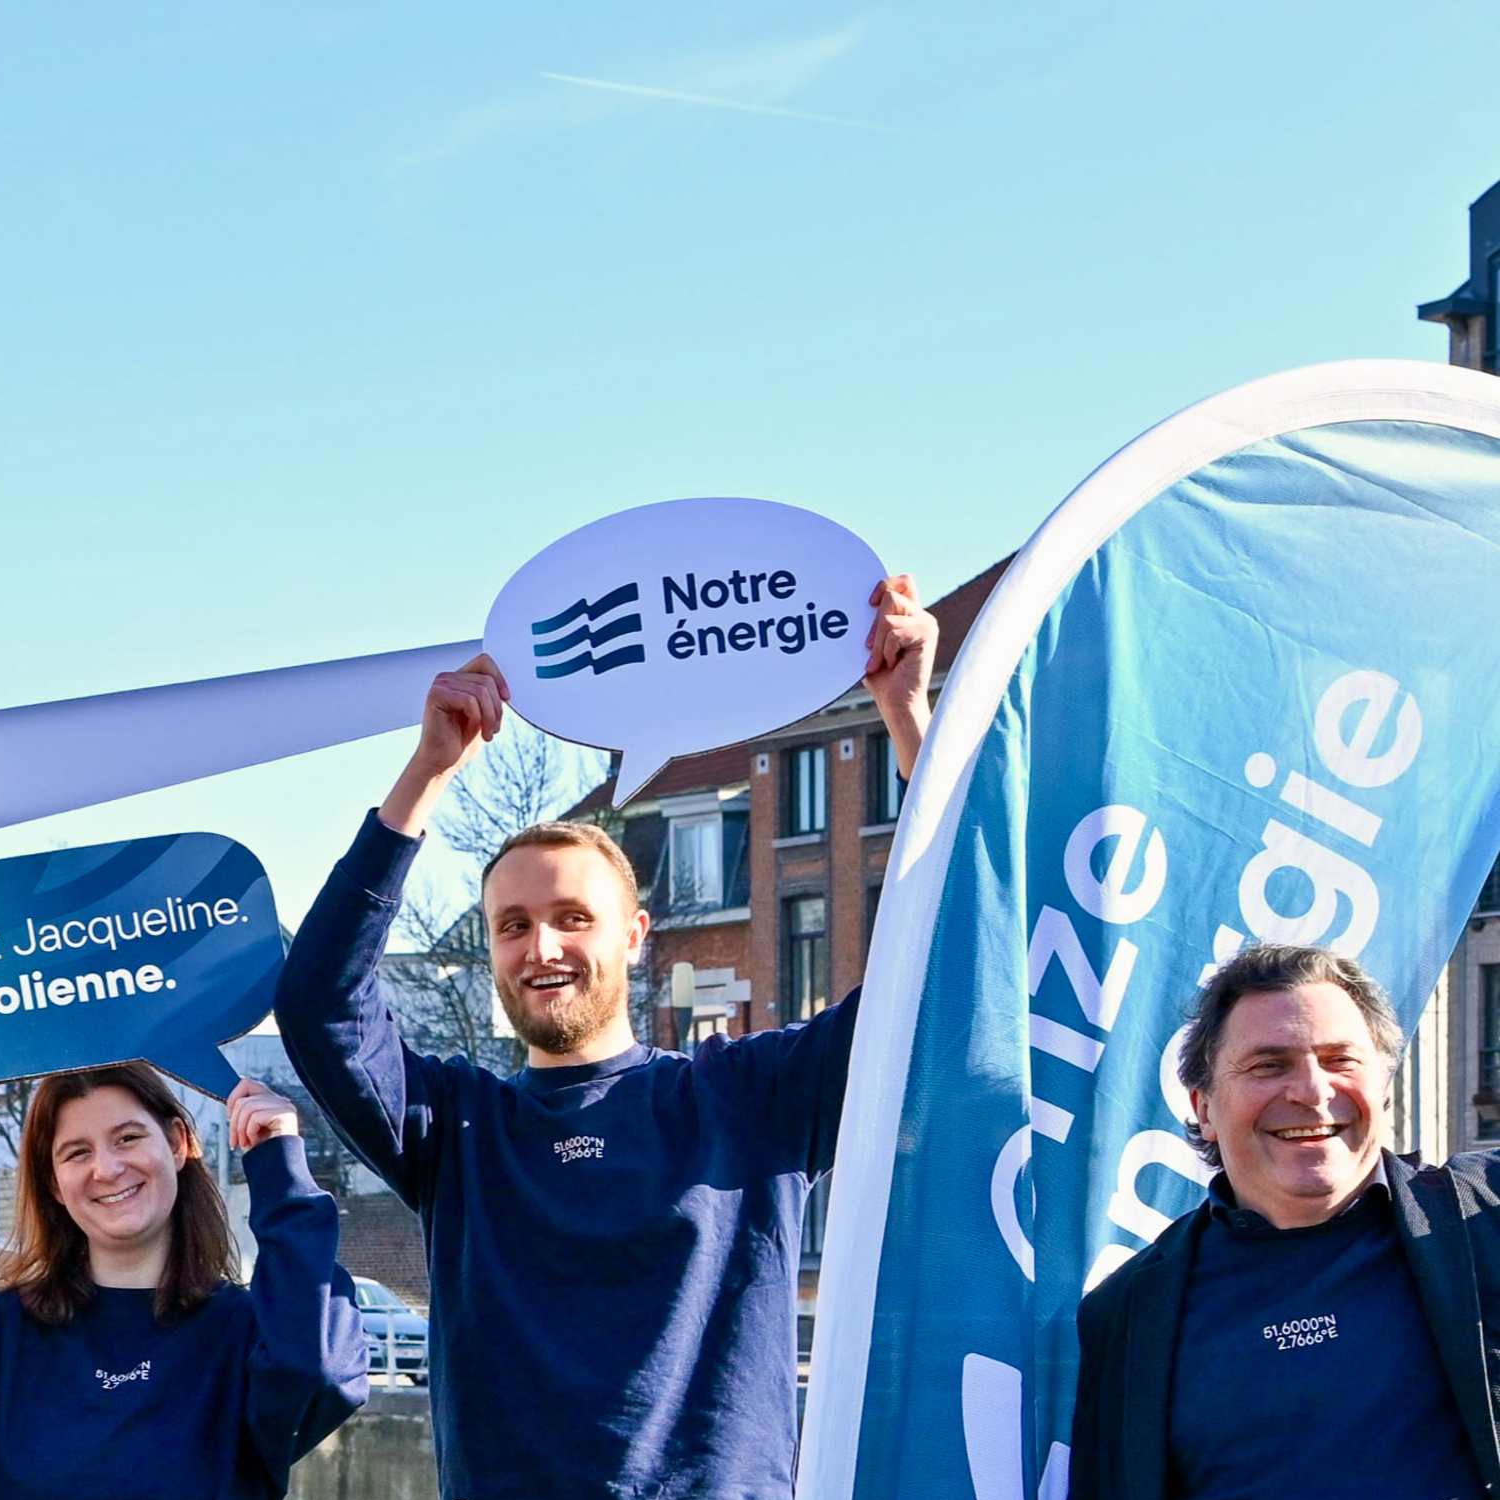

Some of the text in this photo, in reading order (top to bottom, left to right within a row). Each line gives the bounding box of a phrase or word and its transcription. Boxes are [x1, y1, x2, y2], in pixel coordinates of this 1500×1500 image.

[662, 569, 797, 614] Notre
[667, 602, 850, 660] énergie
[12, 896, 249, 957] Jacqueline.
[1263, 1313, 1337, 1339] 51.6000°N
[1276, 1325, 1339, 1350] 2.7666°E
